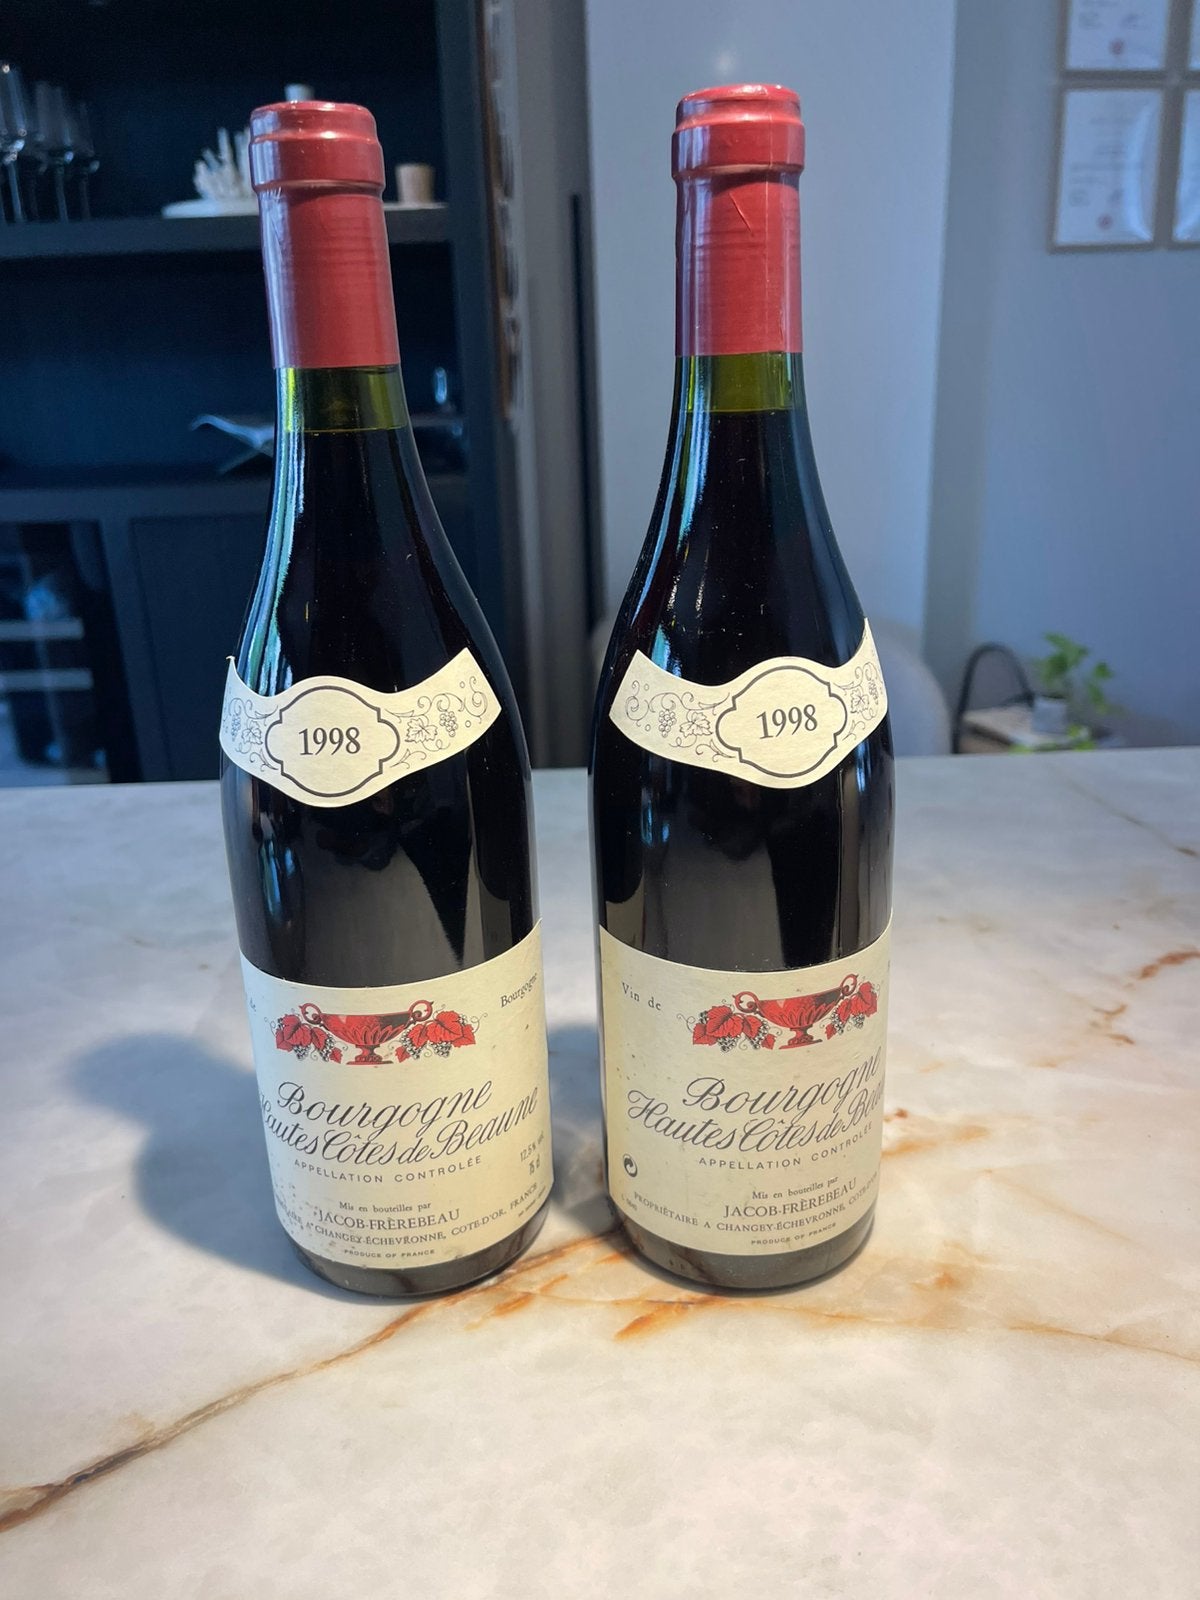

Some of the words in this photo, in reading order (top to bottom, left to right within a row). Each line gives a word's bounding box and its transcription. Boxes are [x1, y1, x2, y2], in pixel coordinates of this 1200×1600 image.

[756, 704, 818, 739] 1998
[298, 726, 361, 755] 1998
[621, 981, 640, 1002] Vin
[647, 995, 662, 1011] de
[682, 1046, 881, 1126] Bourgogne
[277, 1080, 493, 1141] Bourgogne
[627, 1089, 738, 1150] Hautes
[737, 1116, 819, 1153] Côtes
[815, 1111, 843, 1143] de
[322, 1129, 399, 1166] Côtes
[397, 1137, 433, 1165] de
[430, 1086, 539, 1160] Beaune
[294, 1159, 384, 1184] APPELLATION
[393, 1153, 483, 1183] CONTROLÉE
[698, 1156, 801, 1171] APPELLATION
[722, 1176, 858, 1219] JACOB-FRÈREBEAU
[752, 1190, 769, 1200] Mis
[772, 1191, 783, 1200] en
[787, 1181, 825, 1198] bouteilles
[317, 1208, 461, 1231] JACOB-FRÈREBEAU
[339, 1201, 355, 1212] Mis
[358, 1205, 369, 1213] en
[372, 1201, 414, 1214] bouteilles
[417, 1202, 432, 1213] par
[633, 1191, 699, 1226] PROPRIÉTAIRE
[750, 1236, 792, 1246] PRODUCE
[793, 1233, 806, 1241] OF
[808, 1221, 837, 1237] FRANCE
[343, 1248, 382, 1259] PRODUCE
[400, 1248, 436, 1258] FRANCE
